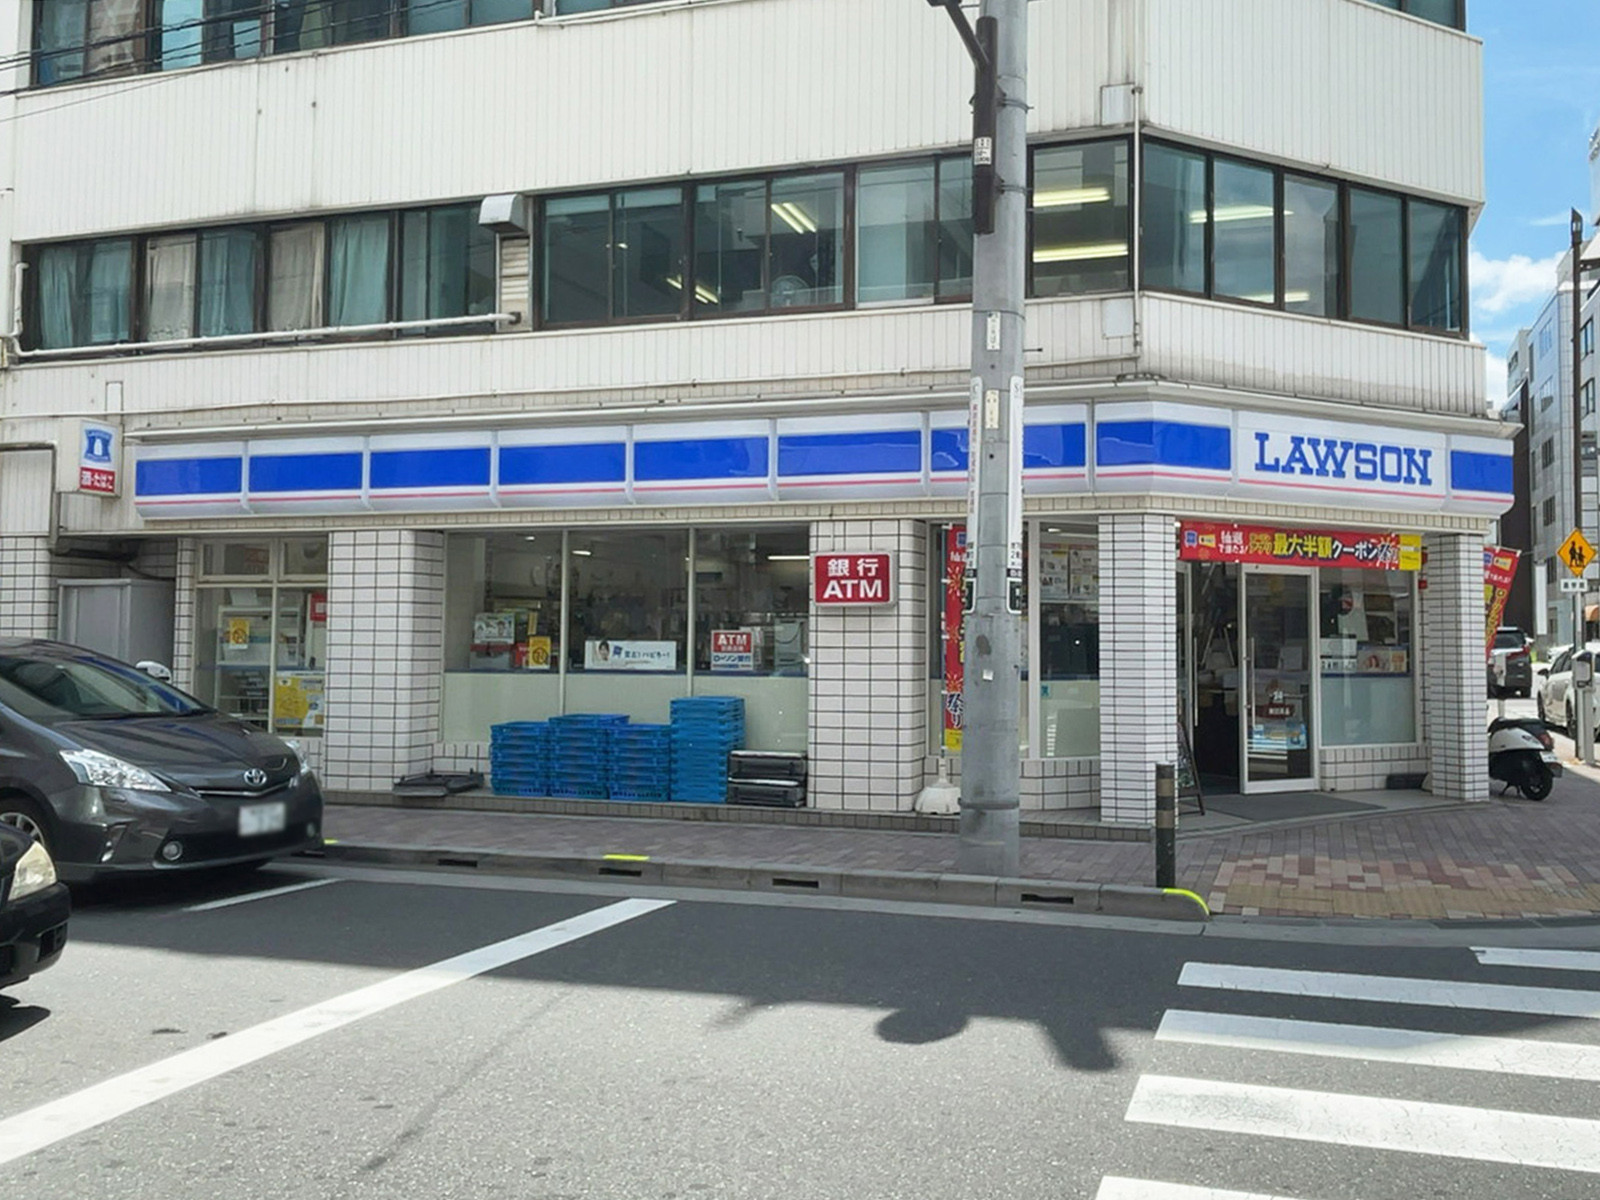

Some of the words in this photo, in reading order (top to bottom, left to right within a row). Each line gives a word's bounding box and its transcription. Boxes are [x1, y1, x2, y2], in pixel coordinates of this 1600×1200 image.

[1254, 431, 1433, 486] LAWSON
[828, 558, 879, 578] 銀行
[823, 580, 883, 599] ATM
[717, 634, 747, 646] ATM
